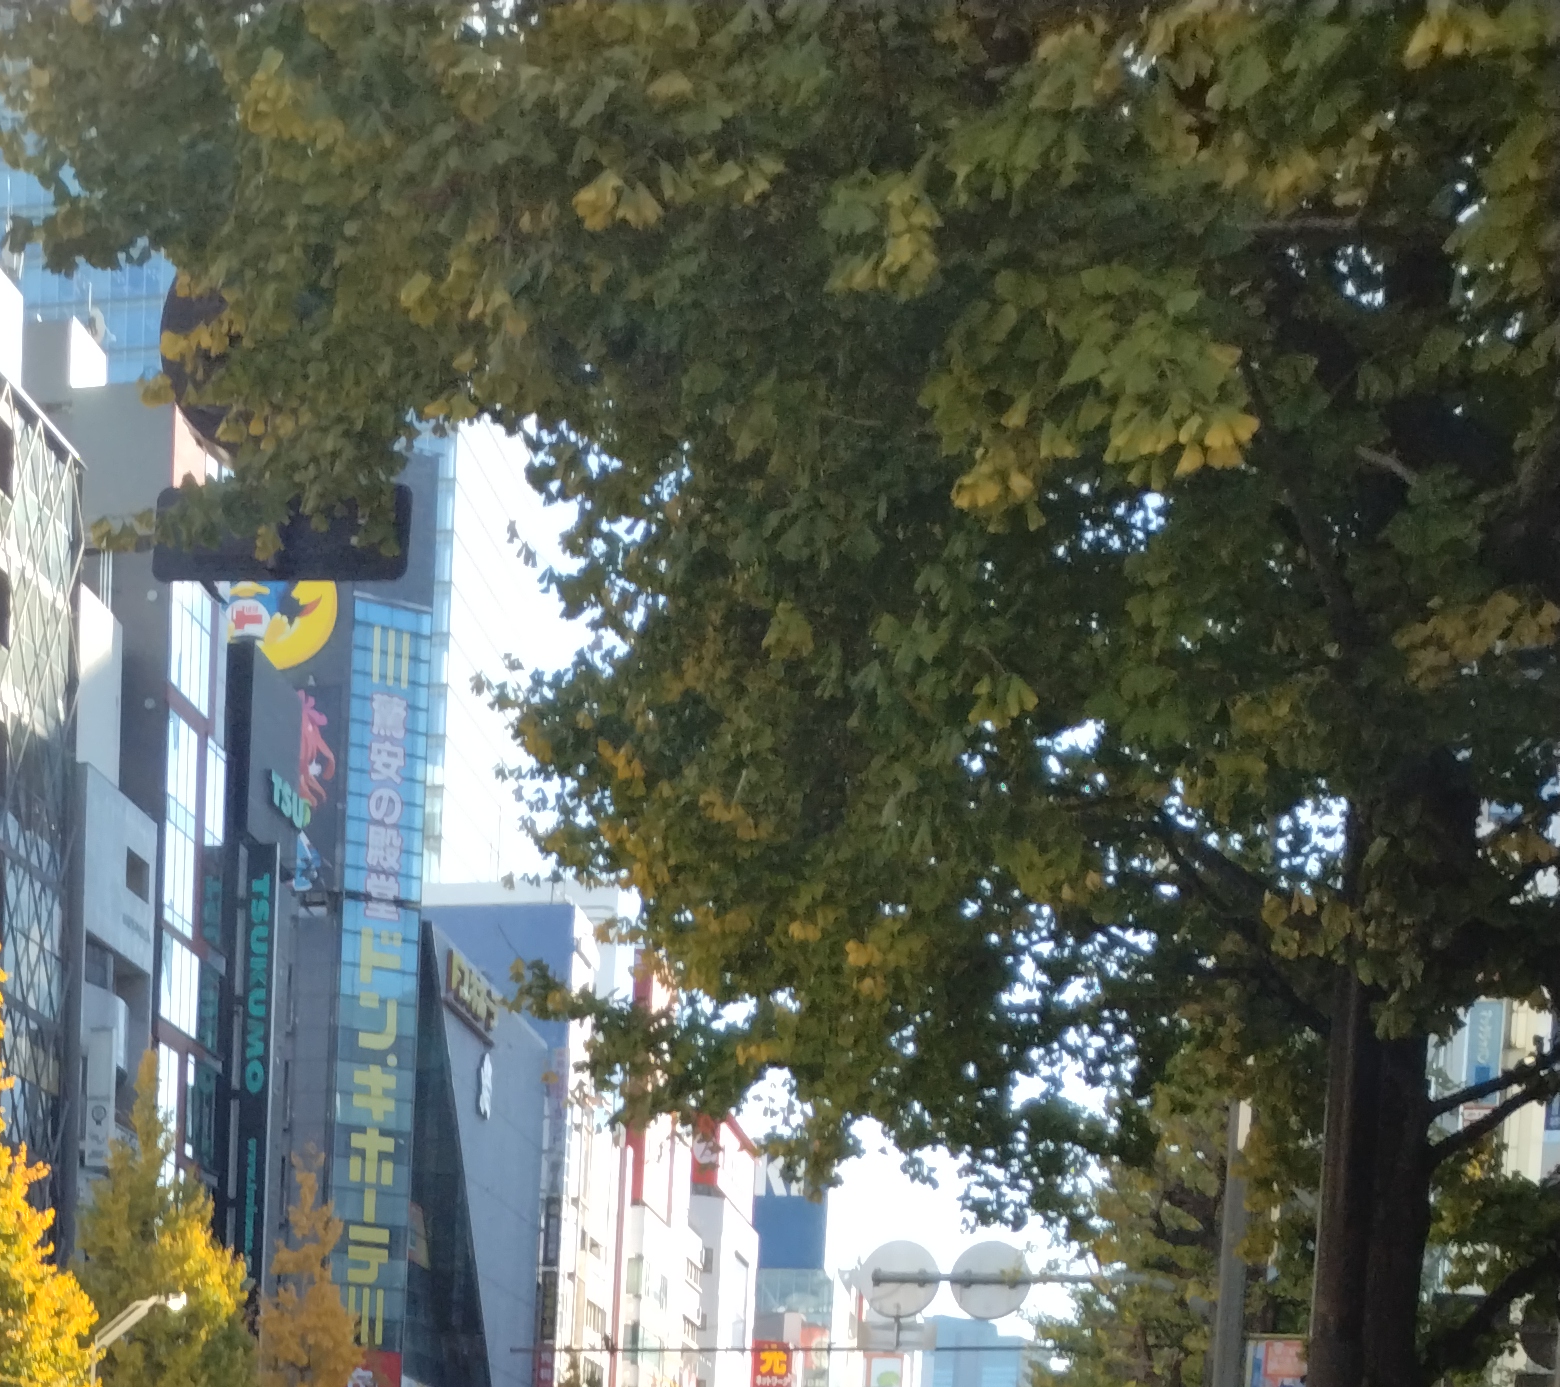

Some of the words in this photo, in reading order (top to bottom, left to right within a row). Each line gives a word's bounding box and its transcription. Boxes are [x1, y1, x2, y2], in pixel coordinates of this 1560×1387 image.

[363, 692, 409, 922] 驚安の殿堂
[245, 873, 271, 1095] TSUKUMO
[347, 926, 402, 1285] ドン・キホーテ
